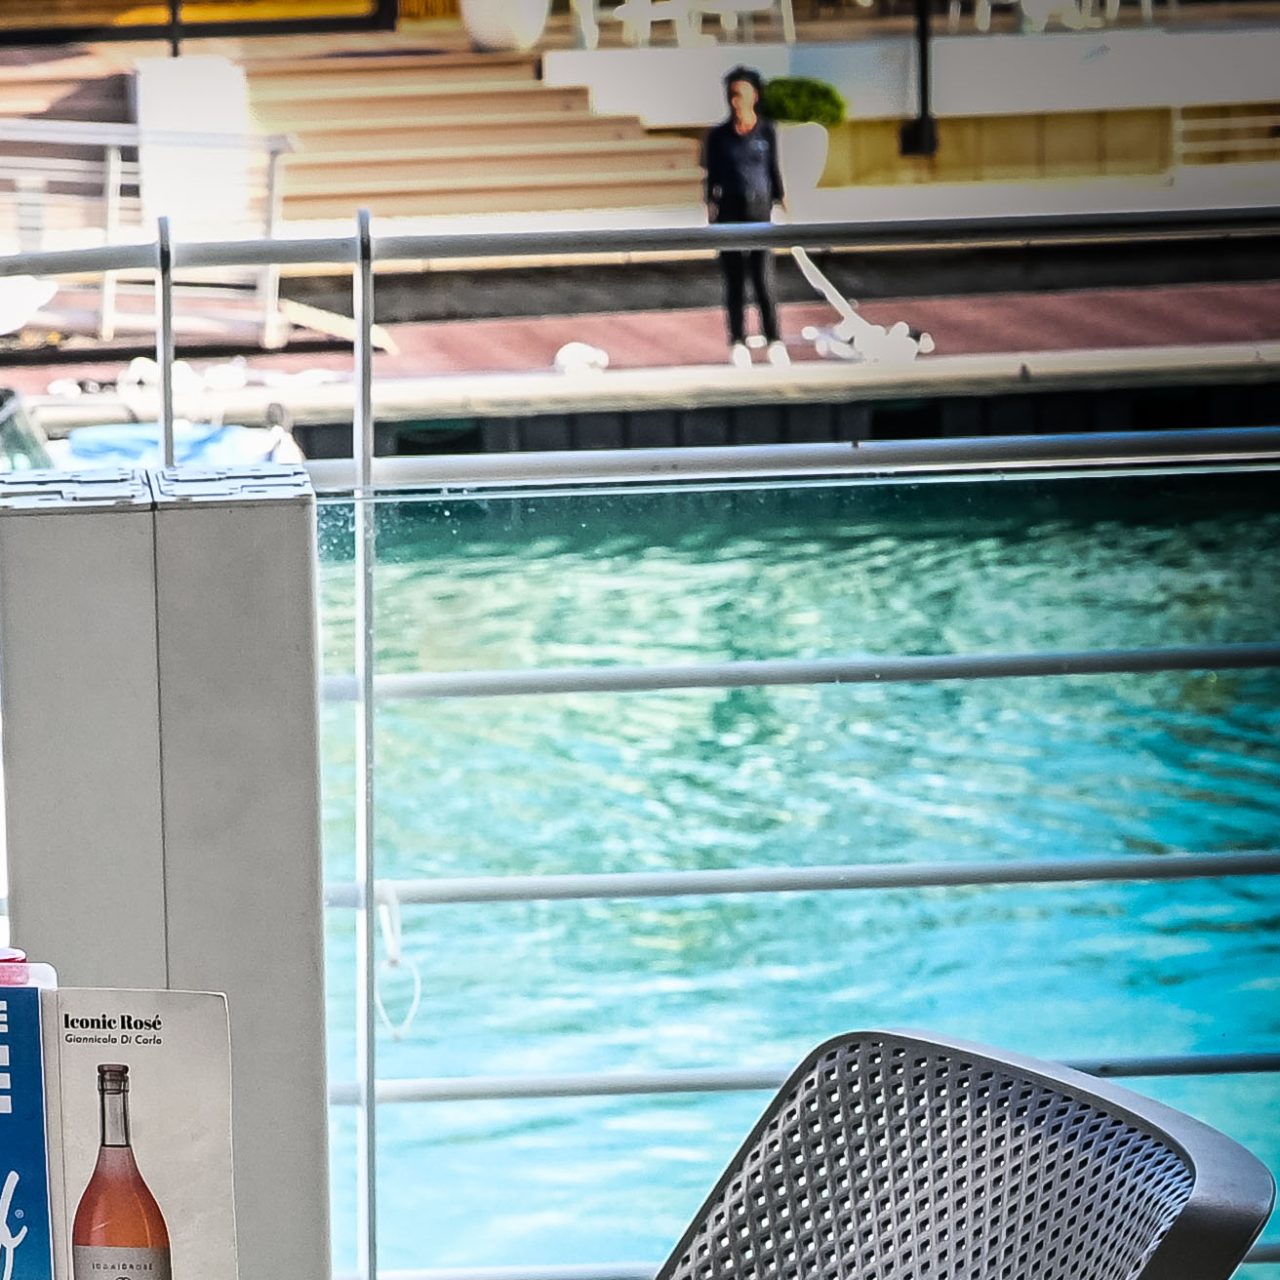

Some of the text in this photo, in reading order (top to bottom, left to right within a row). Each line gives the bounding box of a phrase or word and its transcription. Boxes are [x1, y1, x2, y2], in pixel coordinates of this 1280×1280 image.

[64, 1013, 162, 1031] Iconic Rosé
[65, 1034, 162, 1045] Giannicola Di Carlo
